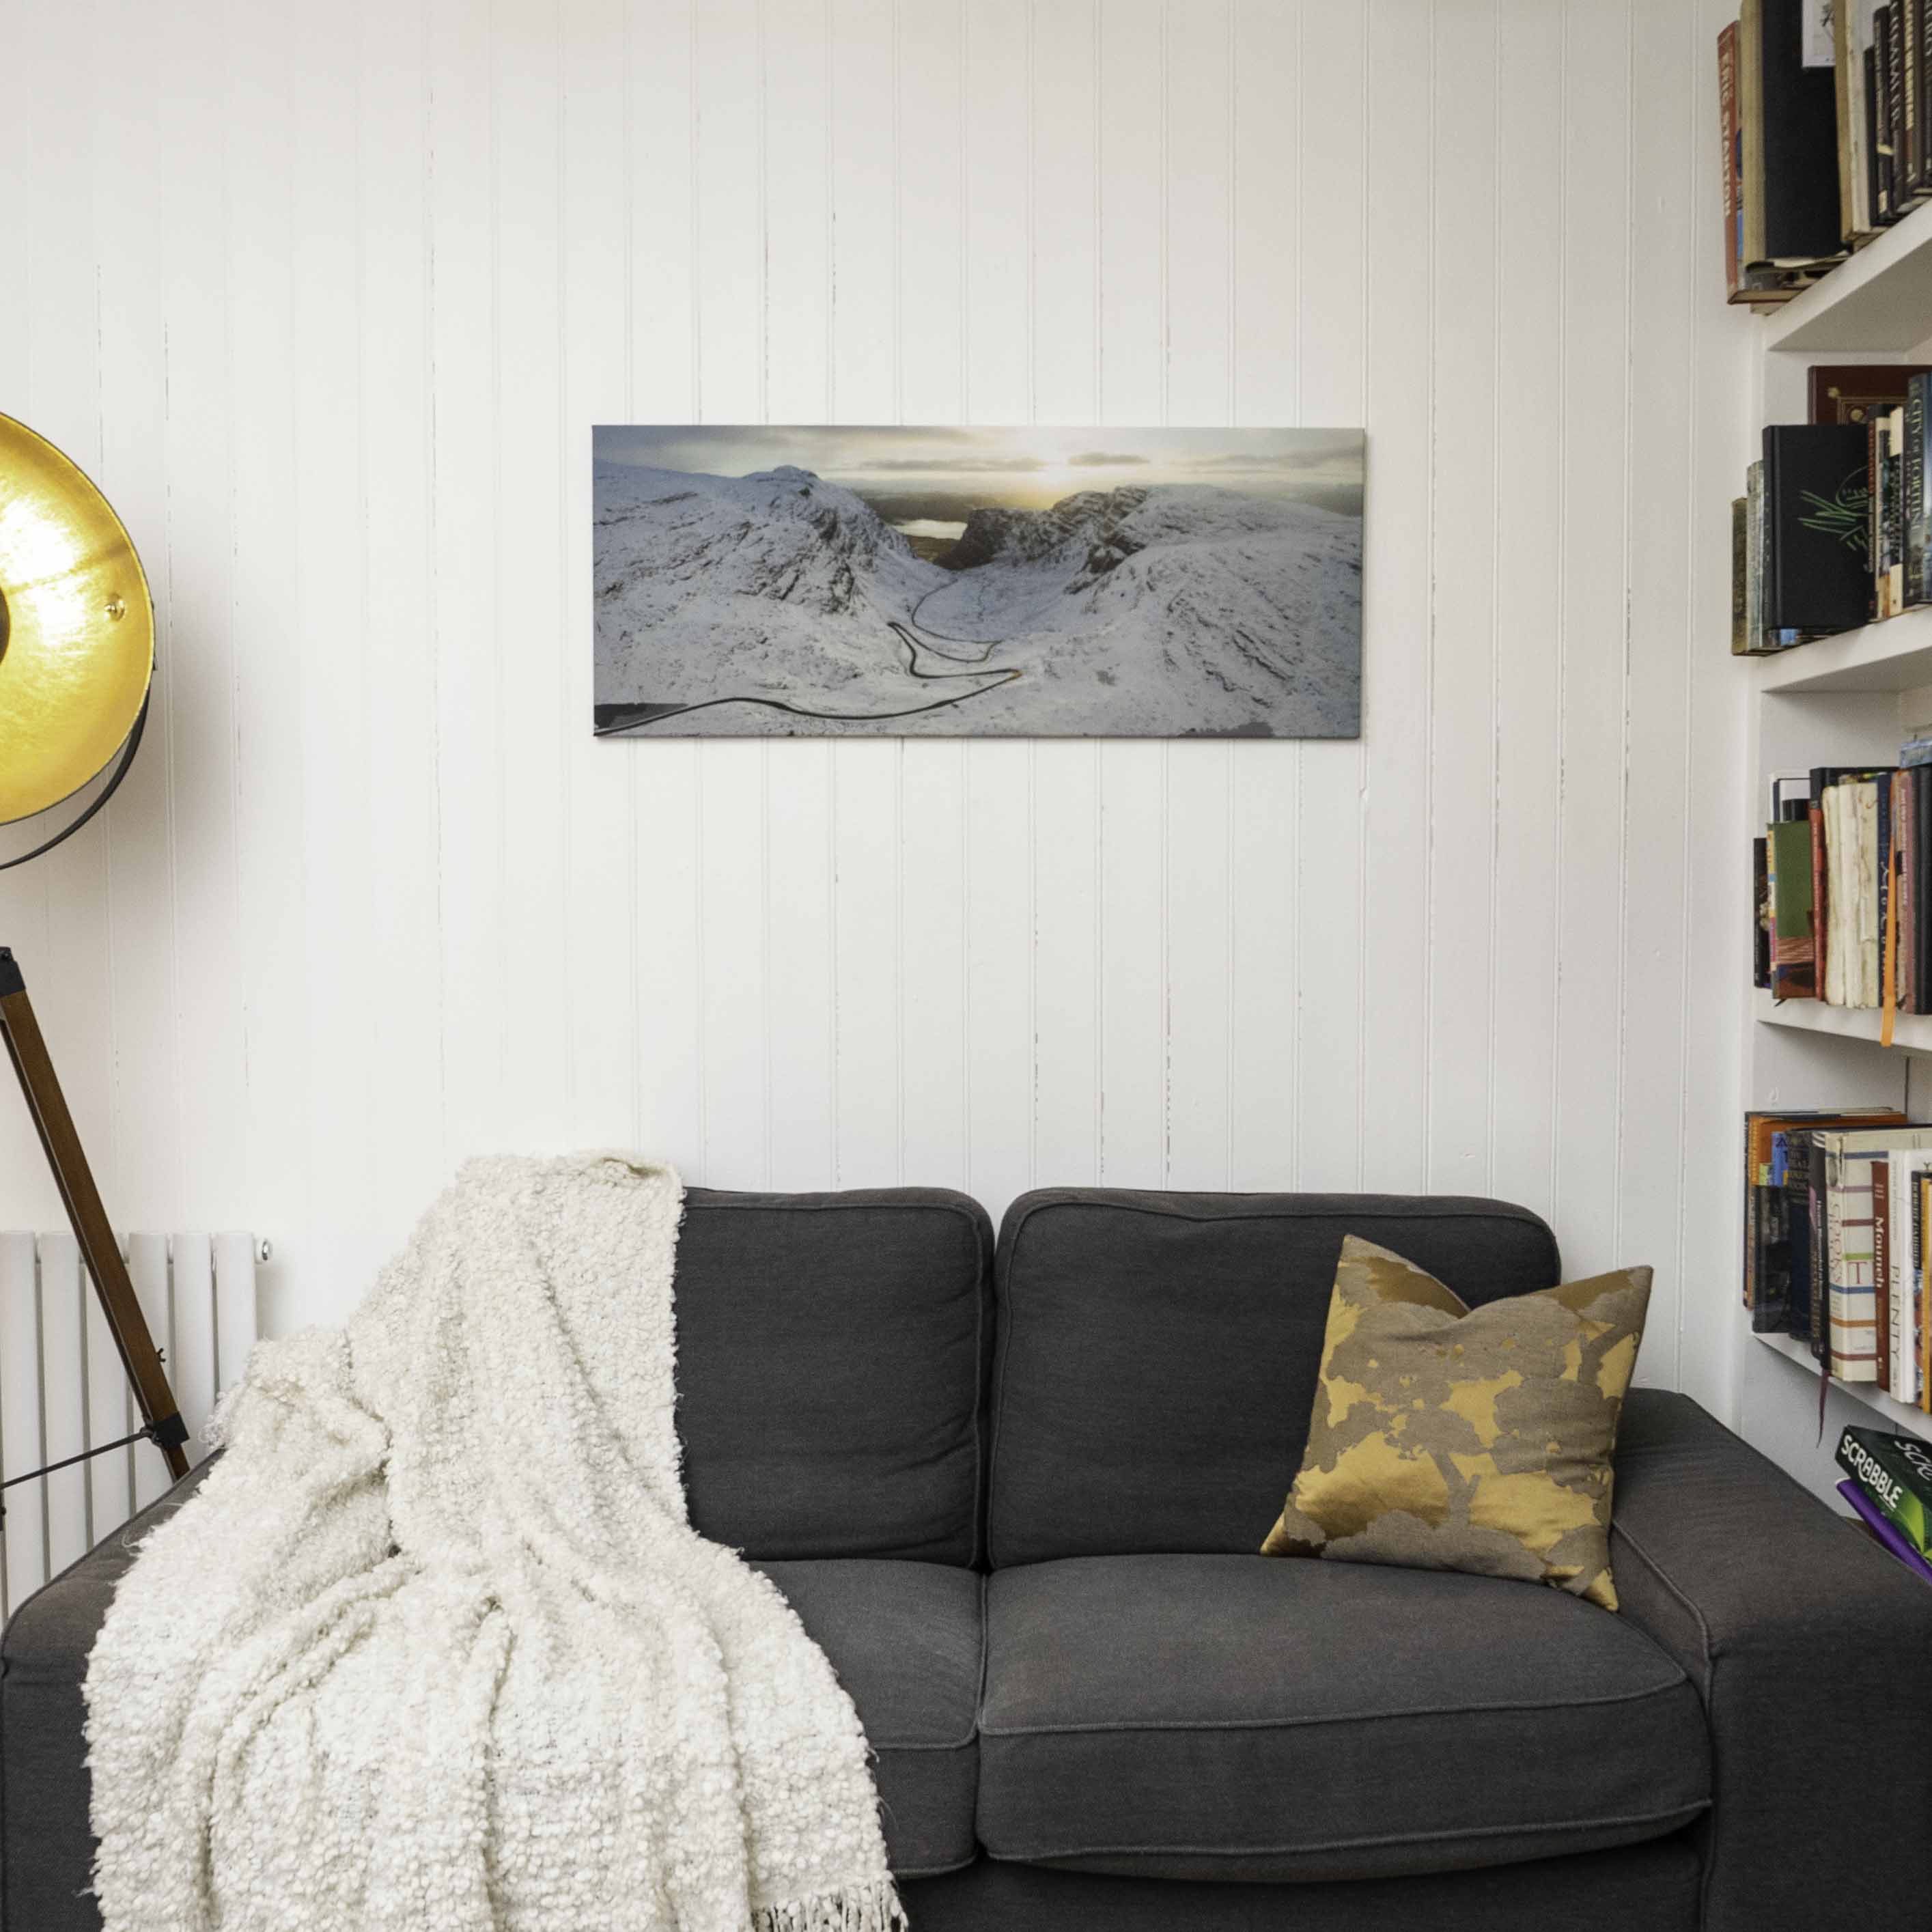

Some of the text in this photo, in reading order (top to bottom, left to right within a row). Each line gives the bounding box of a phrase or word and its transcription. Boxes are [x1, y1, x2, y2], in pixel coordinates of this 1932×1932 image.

[1874, 1216, 1885, 1288] Mouneh
[1890, 1265, 1901, 1360] PLENTY
[1841, 1434, 1903, 1509] SCRABBLE
